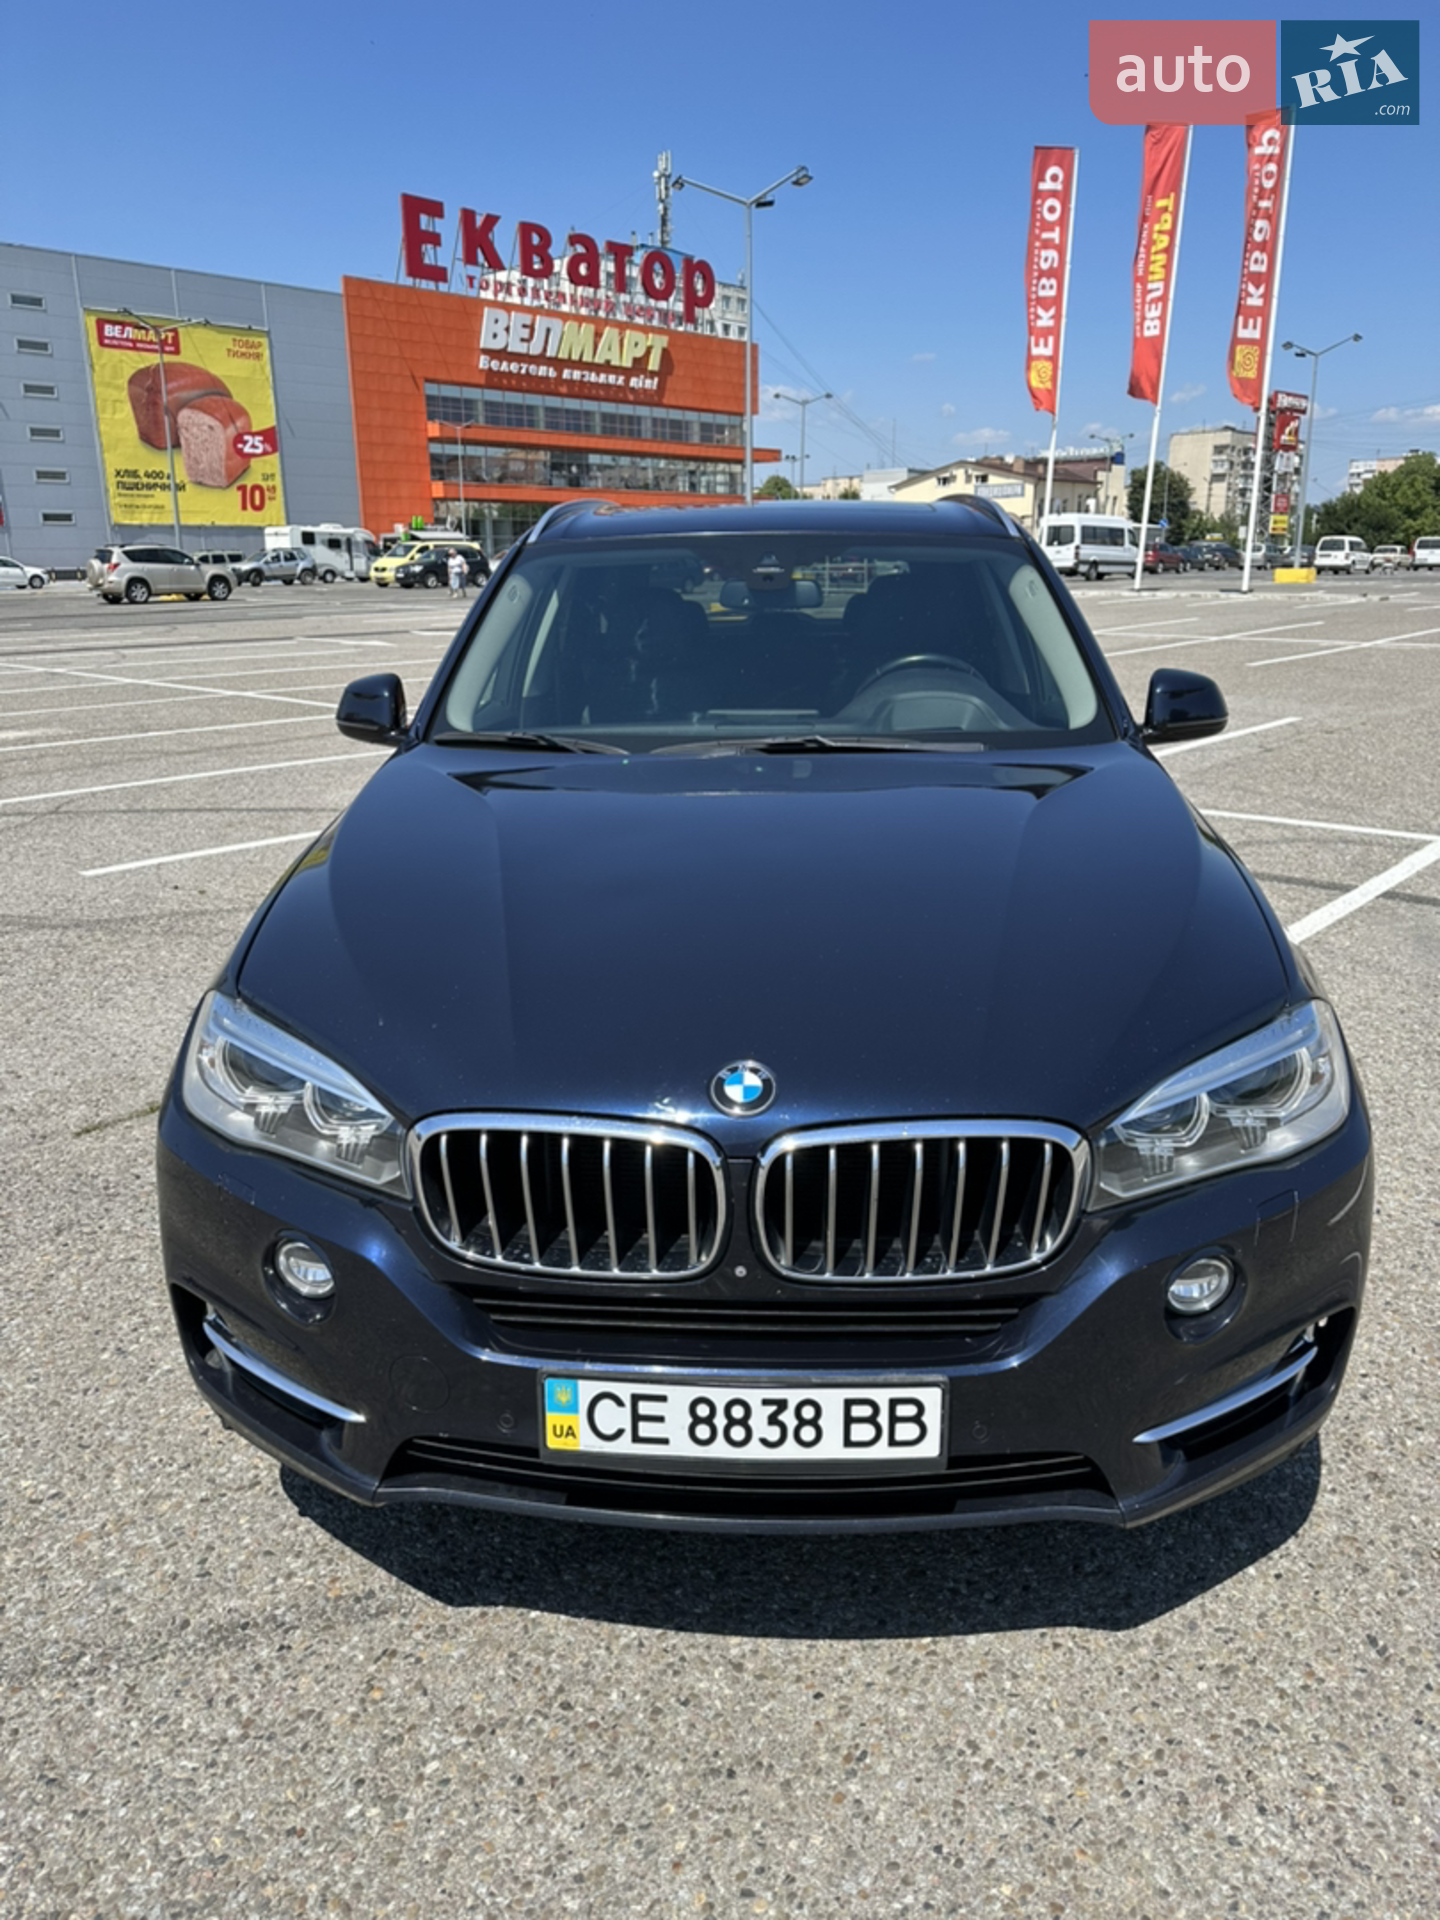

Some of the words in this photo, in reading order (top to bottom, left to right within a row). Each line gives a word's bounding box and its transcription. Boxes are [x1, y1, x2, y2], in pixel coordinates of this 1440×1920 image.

[401, 192, 715, 324] Екватор
[231, 337, 263, 350] ТОВАР
[480, 306, 669, 372] ВЕЛМАРТ
[144, 470, 165, 480] 400
[235, 484, 265, 512] 10
[552, 1424, 577, 1440] UA
[586, 1391, 670, 1445] CE
[688, 1396, 823, 1449] 8838
[843, 1397, 928, 1449] BB
